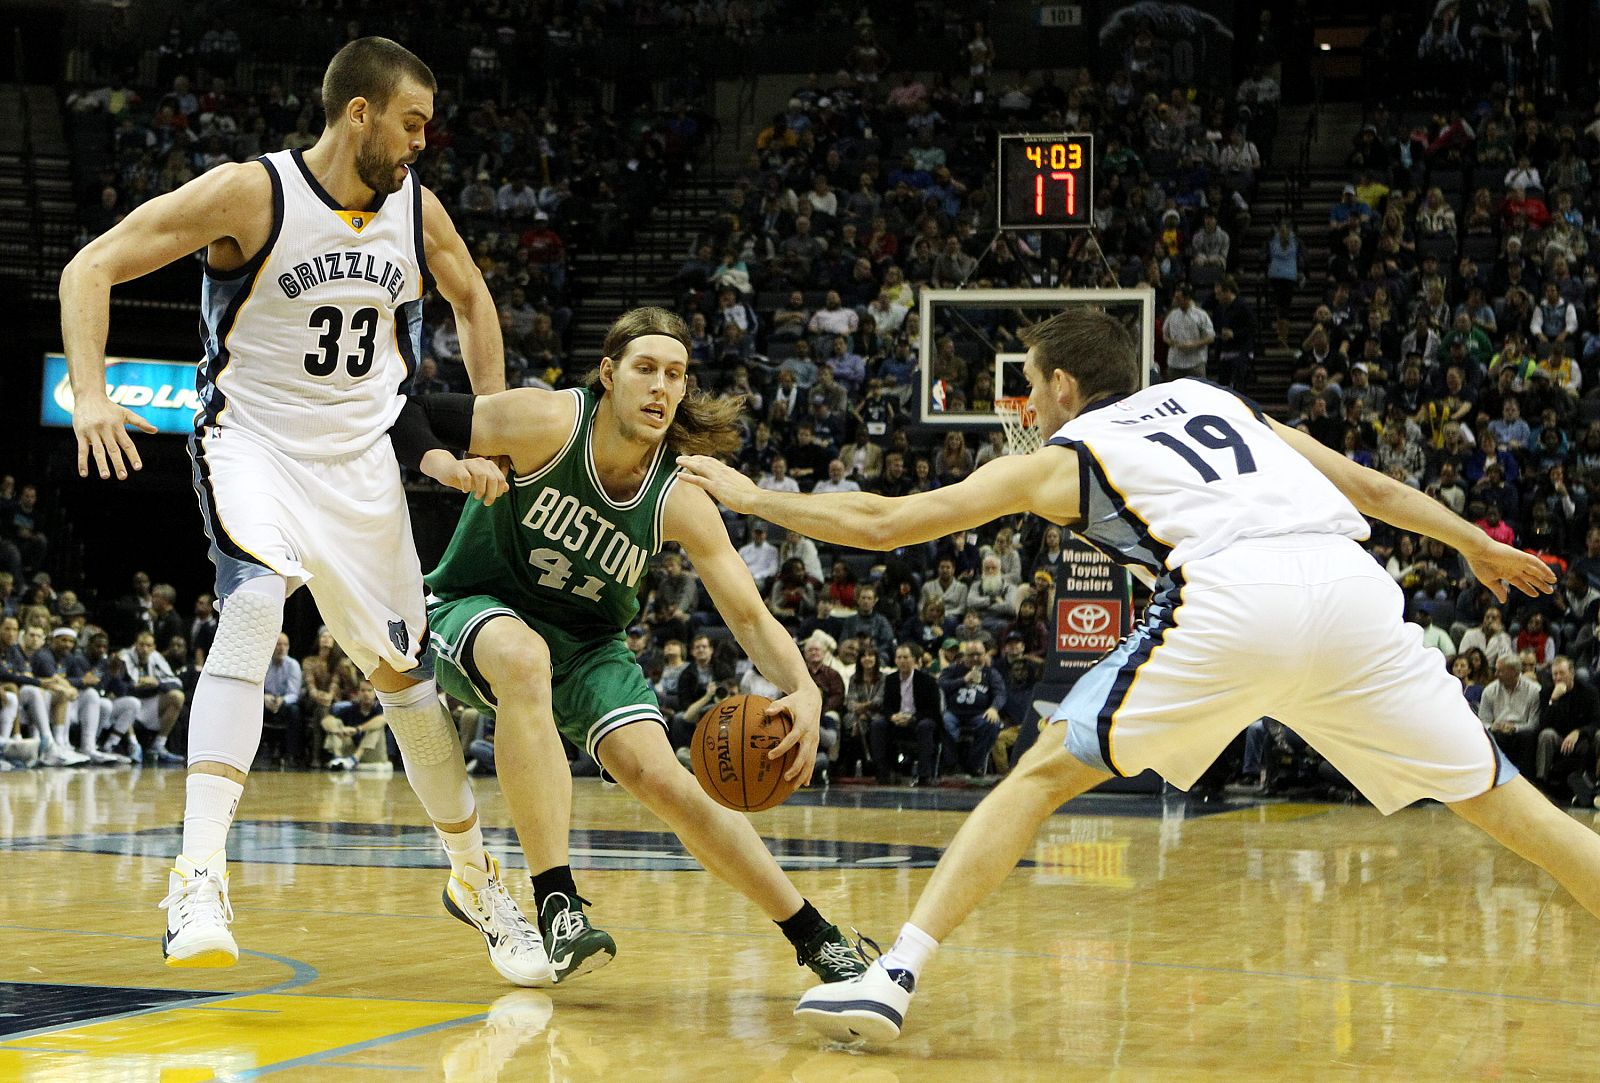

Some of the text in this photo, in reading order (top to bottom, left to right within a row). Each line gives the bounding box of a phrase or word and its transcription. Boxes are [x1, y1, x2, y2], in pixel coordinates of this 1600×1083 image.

[1026, 143, 1082, 169] 4:03
[1035, 172, 1075, 216] 17
[303, 306, 379, 378] 33
[1143, 414, 1257, 484] 19
[521, 486, 648, 588] BOSTON
[1062, 549, 1114, 564] Memphi
[1070, 563, 1110, 578] Toyota
[528, 547, 607, 603] 41
[1066, 578, 1113, 592] Dealers
[1060, 633, 1116, 648] TOYOTA
